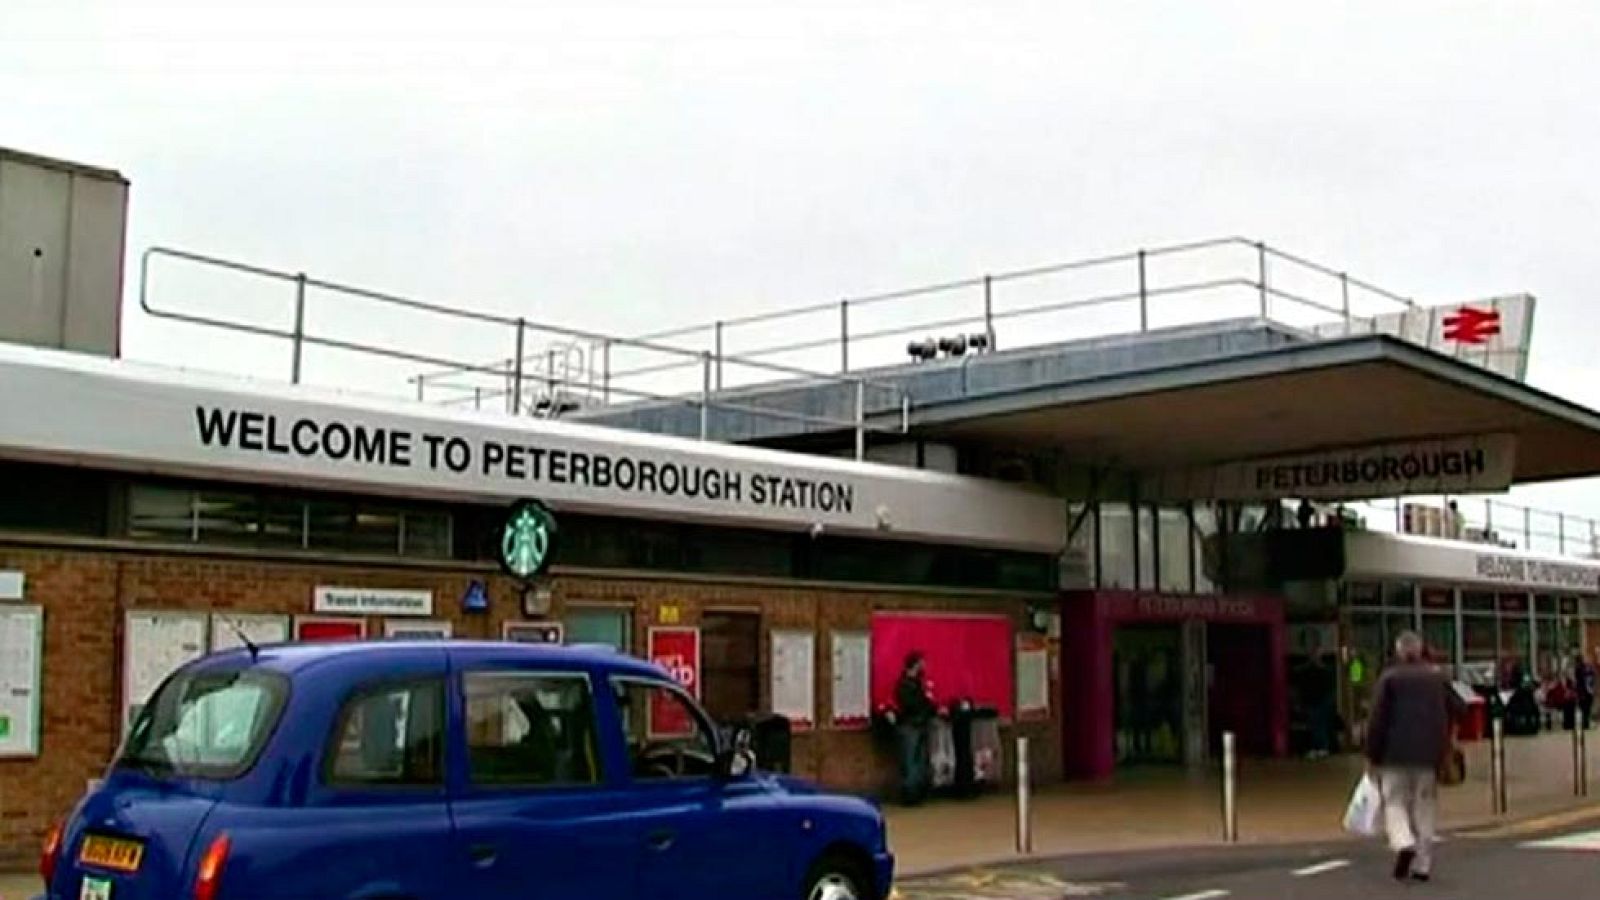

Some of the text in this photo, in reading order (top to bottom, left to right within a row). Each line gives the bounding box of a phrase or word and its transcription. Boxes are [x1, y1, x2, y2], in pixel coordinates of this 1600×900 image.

[195, 405, 853, 513] WELCOME TO PETERBOROUGH STATION
[1255, 448, 1485, 490] PETERBOROUGH
